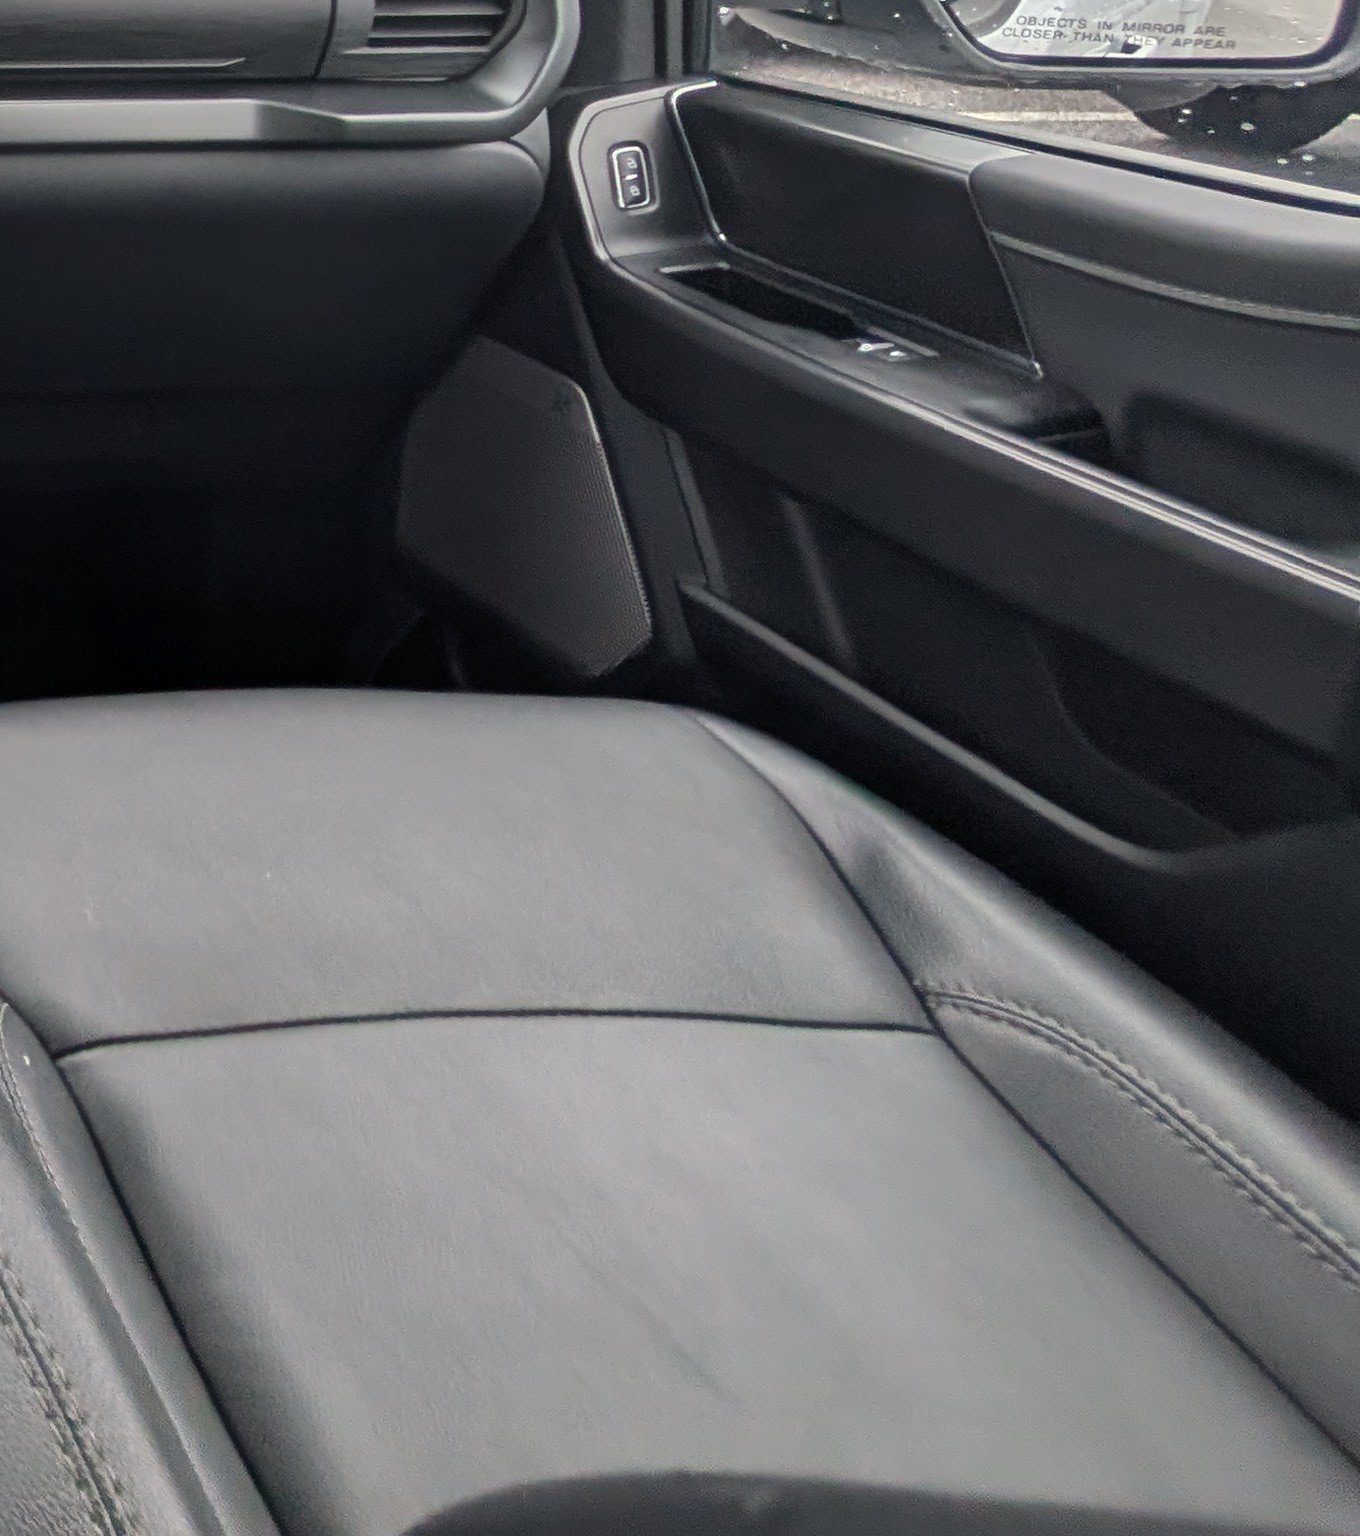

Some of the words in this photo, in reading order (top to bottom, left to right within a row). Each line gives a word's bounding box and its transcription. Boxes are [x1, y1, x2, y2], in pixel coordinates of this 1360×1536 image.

[1015, 15, 1088, 30] OBJECTS
[1097, 20, 1113, 31] IN
[1121, 21, 1186, 35] MIRROR
[1193, 25, 1226, 37] ARE
[1002, 26, 1063, 39] CLOSER
[1072, 31, 1115, 44] THAN
[1124, 33, 1166, 47] THEY
[1171, 36, 1237, 50] APPEAR
